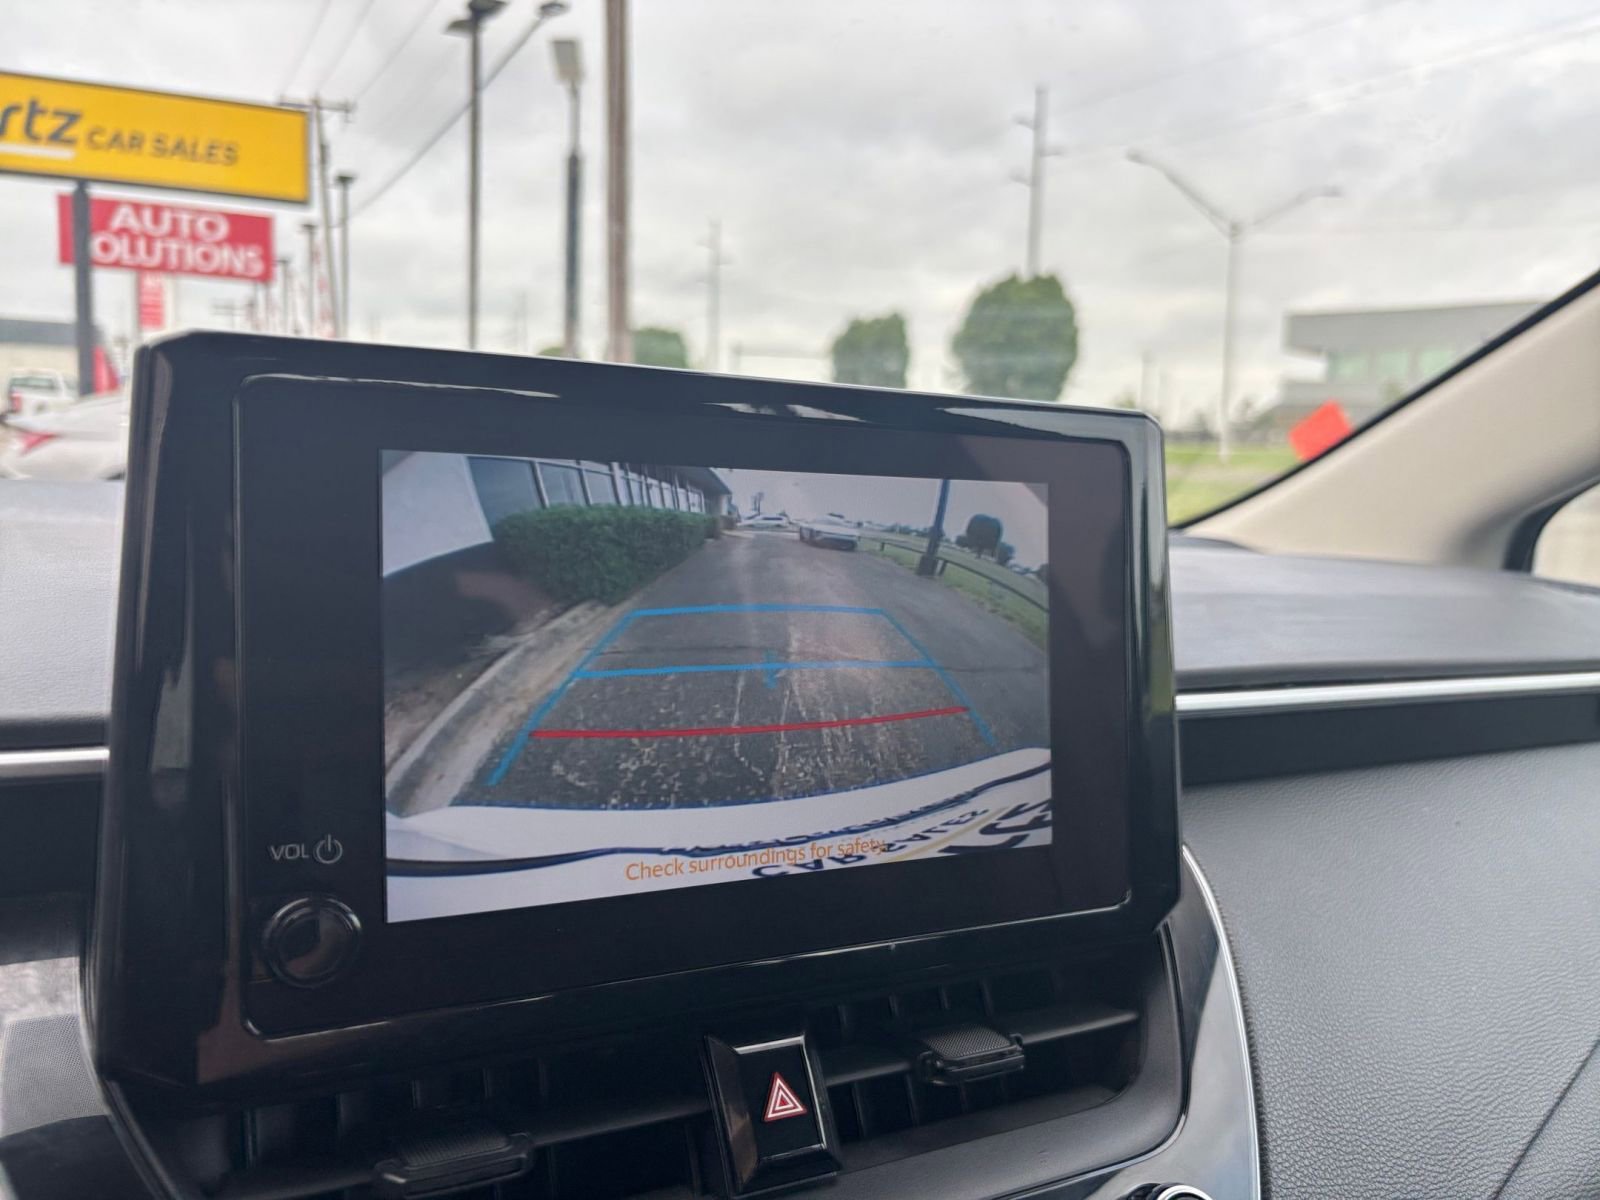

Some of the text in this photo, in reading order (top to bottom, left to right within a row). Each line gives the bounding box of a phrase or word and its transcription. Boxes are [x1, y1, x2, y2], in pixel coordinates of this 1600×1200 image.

[0, 98, 239, 166] rtz CAR SALES
[110, 205, 229, 242] AUTO
[90, 232, 264, 277] OLUTIONS
[269, 843, 310, 861] VOL
[625, 836, 887, 881] Check surroundings for safety
